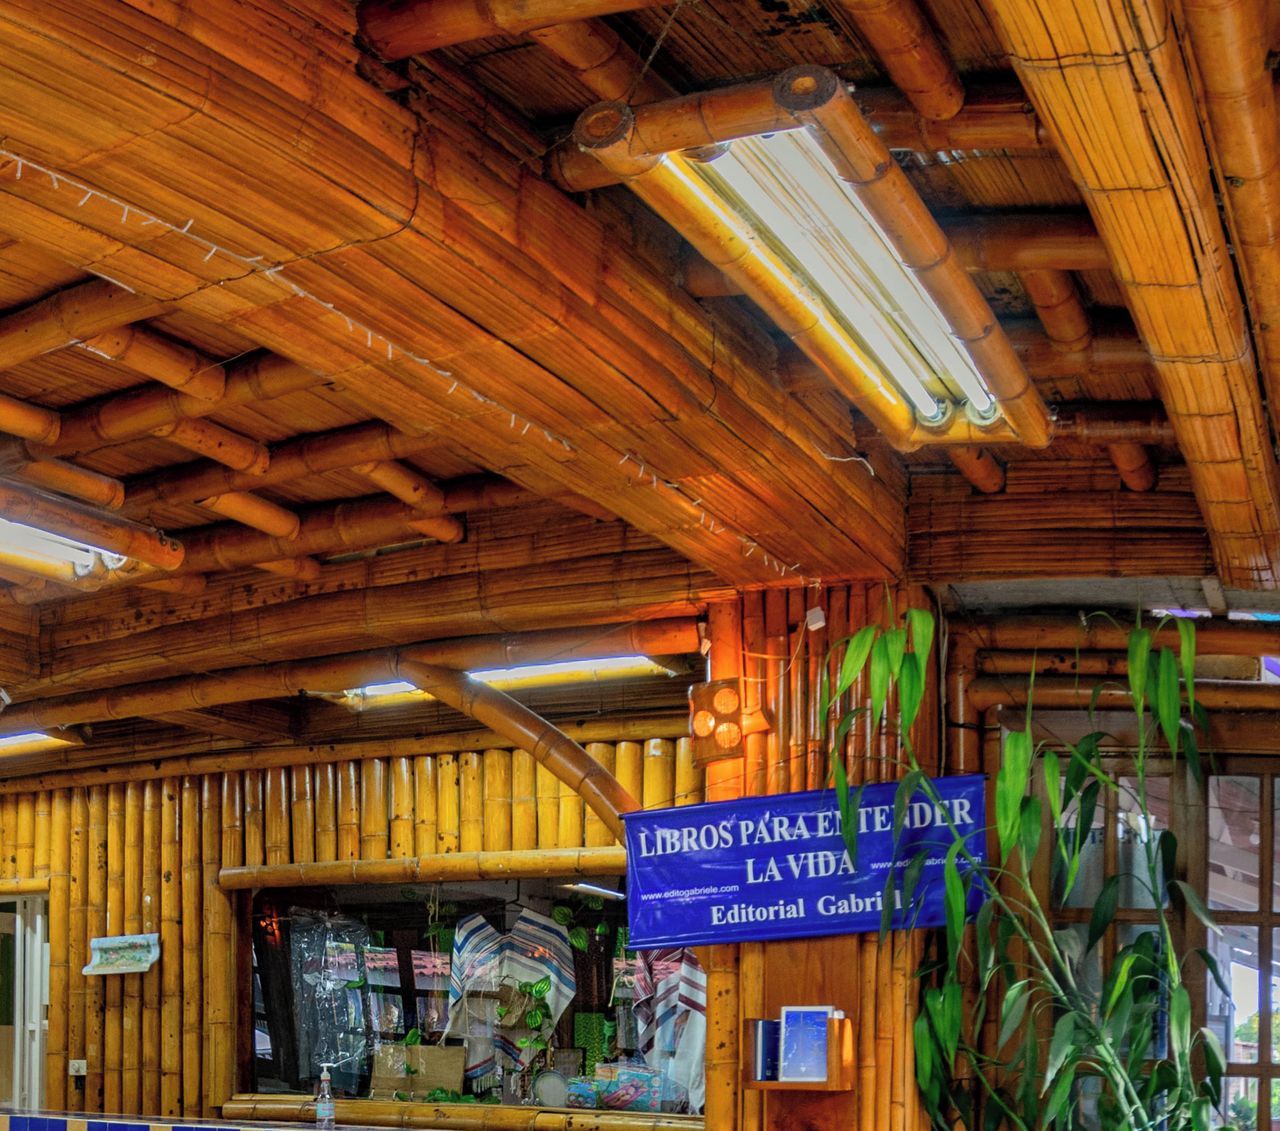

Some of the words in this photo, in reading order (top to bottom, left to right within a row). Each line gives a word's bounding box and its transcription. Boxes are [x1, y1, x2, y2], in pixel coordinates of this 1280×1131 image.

[639, 823, 734, 857] LIBROS
[739, 814, 811, 846] PARA
[746, 856, 783, 884] LA
[786, 849, 856, 879] VIDA
[641, 884, 739, 901] www.editogabriele.com
[710, 898, 806, 925] Editorial
[817, 890, 914, 916] Gabril
